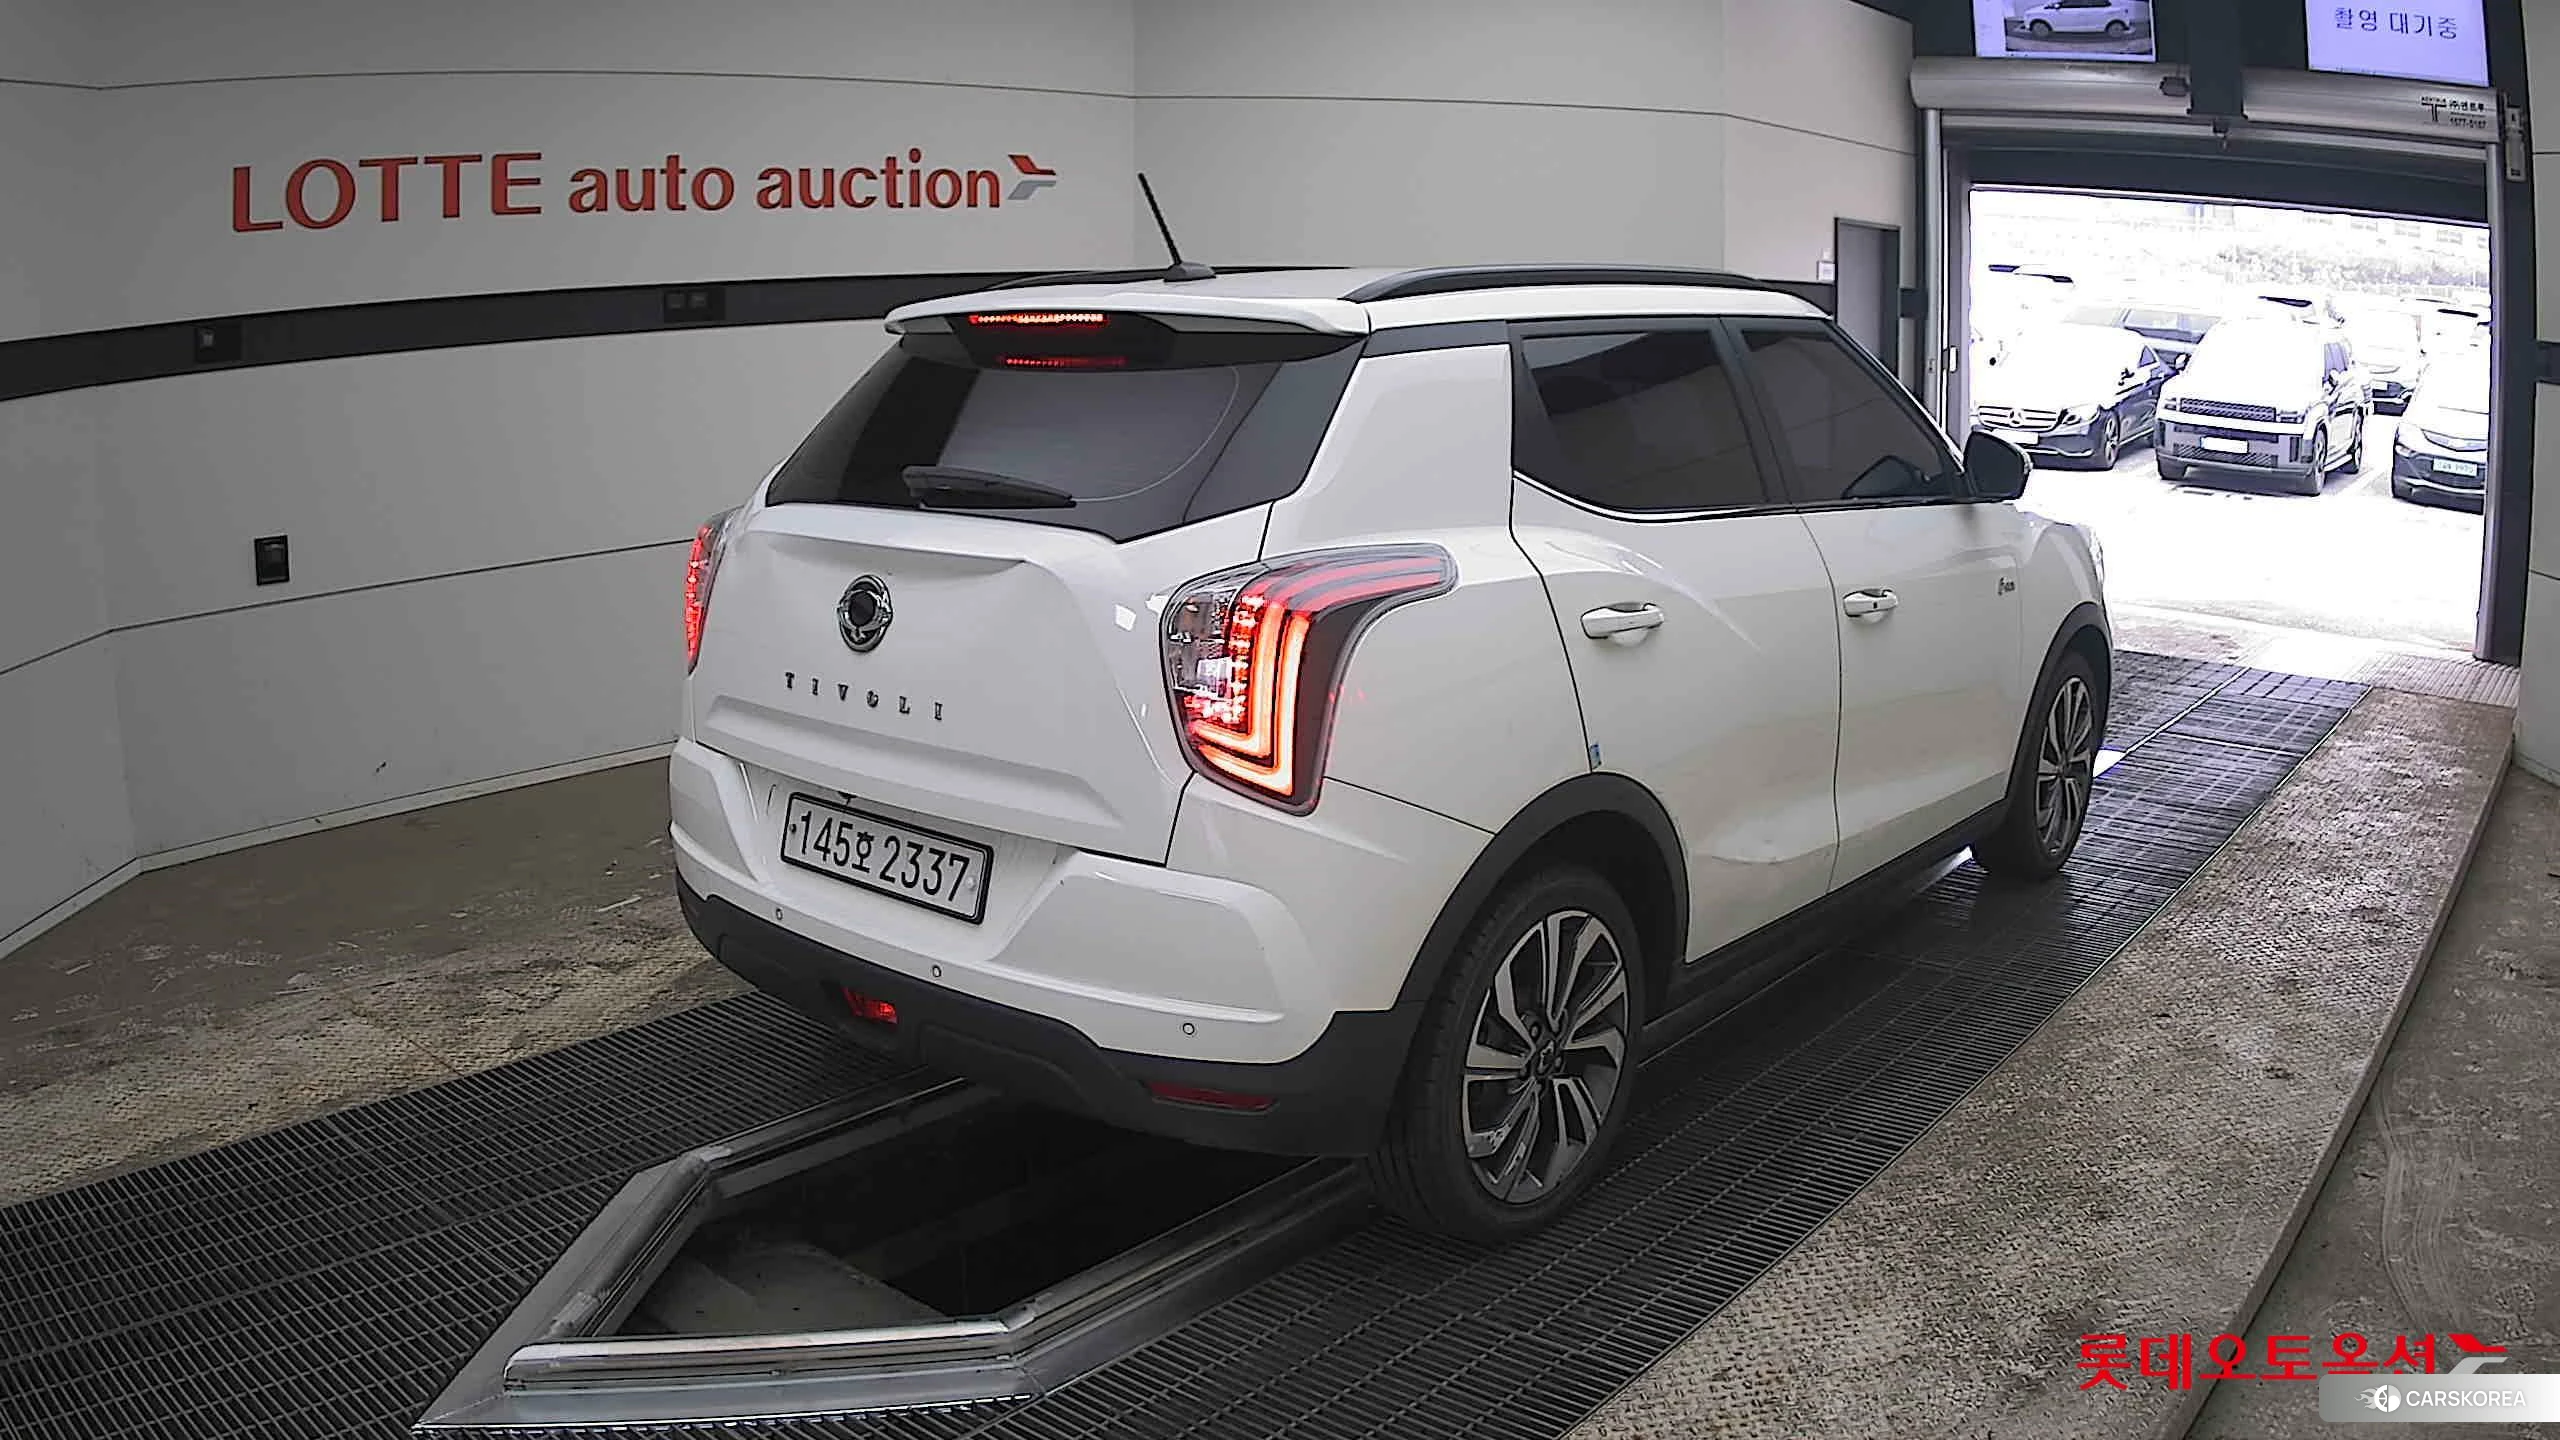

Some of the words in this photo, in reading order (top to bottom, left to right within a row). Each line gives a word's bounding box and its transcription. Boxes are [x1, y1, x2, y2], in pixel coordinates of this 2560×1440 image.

[2389, 11, 2458, 40] 대기중
[231, 151, 543, 233] LOTTE
[567, 153, 736, 214] auto
[755, 146, 1001, 210] auction
[784, 671, 944, 722] TIVOLI
[879, 835, 971, 902] 2337
